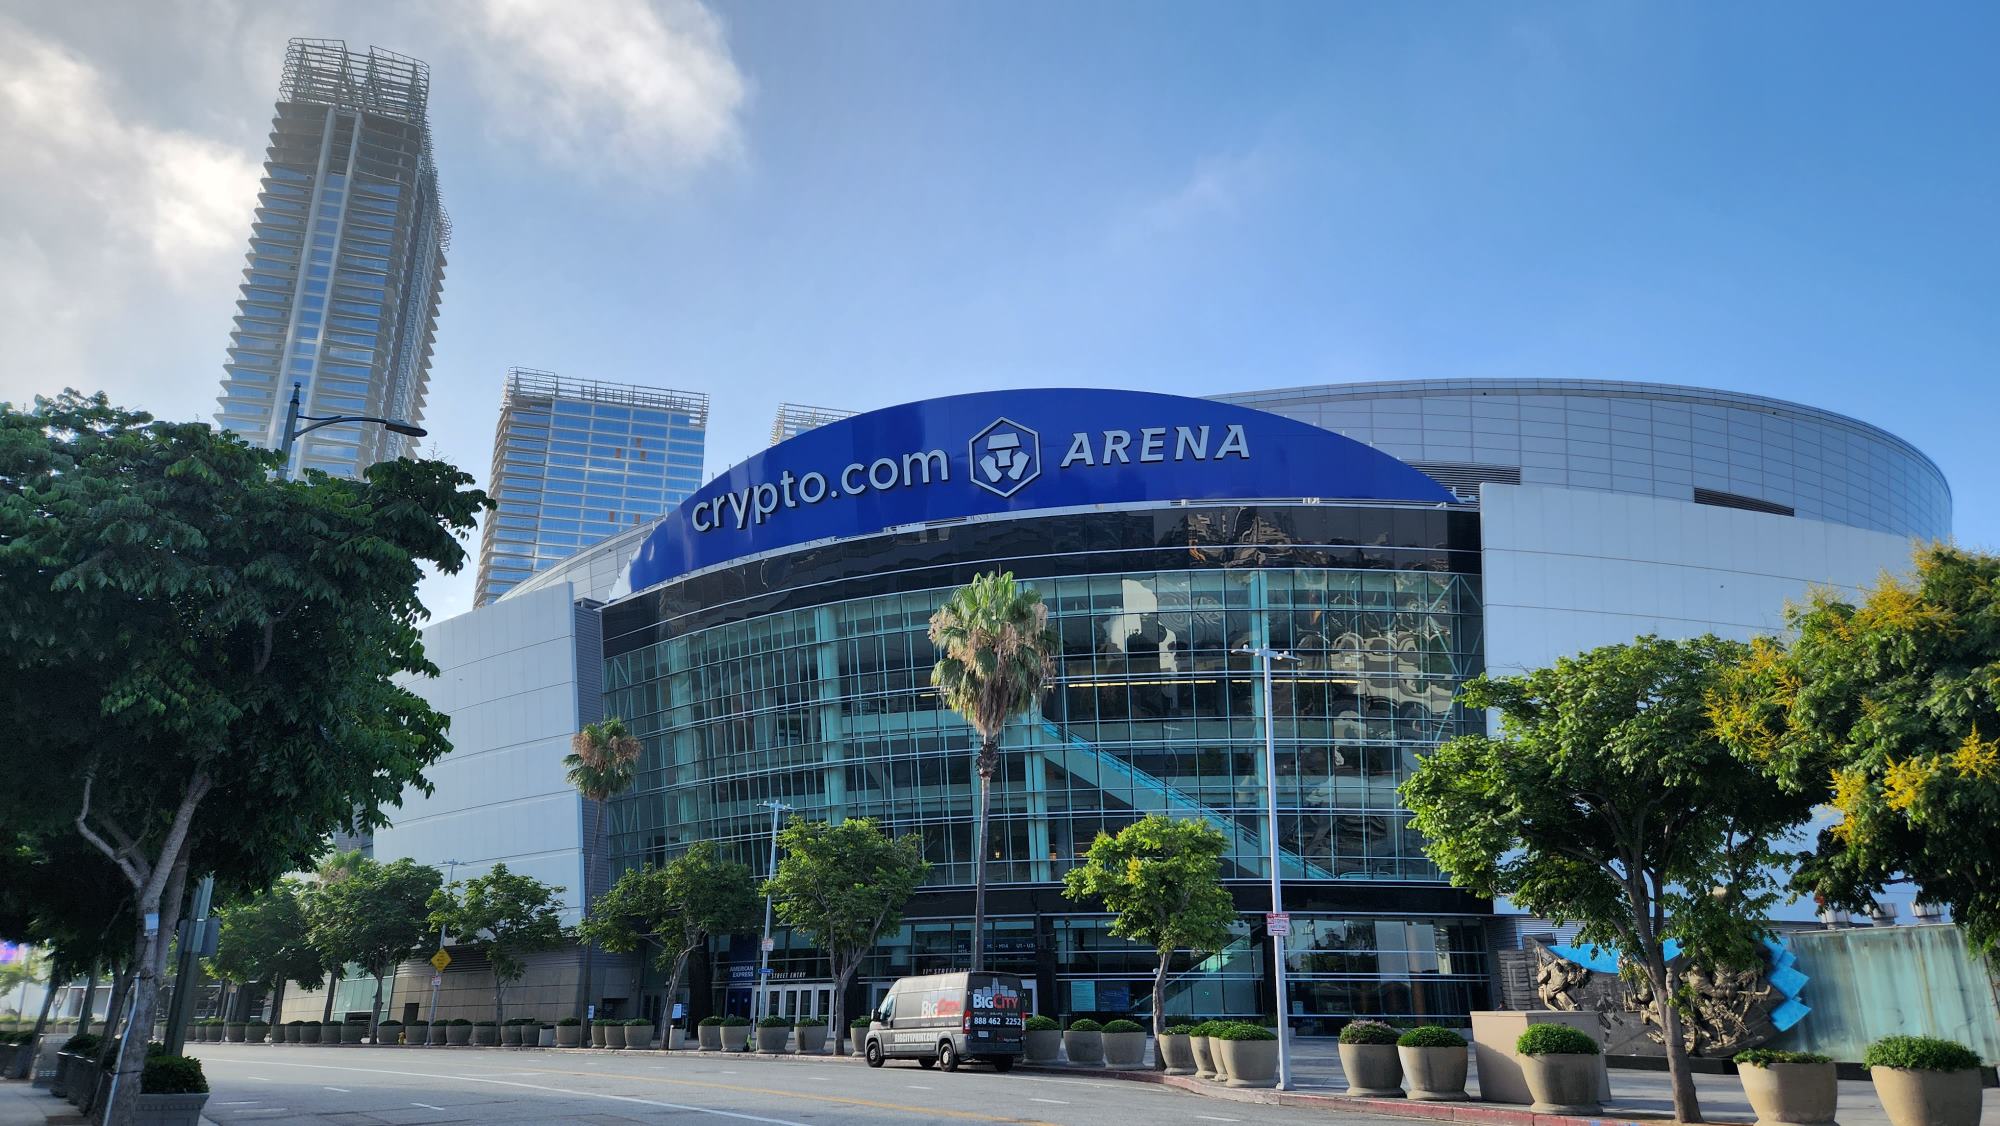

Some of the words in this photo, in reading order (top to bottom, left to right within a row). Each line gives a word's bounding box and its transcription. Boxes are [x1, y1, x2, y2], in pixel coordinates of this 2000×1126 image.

[691, 447, 948, 533] crypto.com
[1061, 424, 1250, 468] ARENA
[974, 1017, 987, 1025] 888
[988, 1017, 1001, 1025] 462
[1005, 1017, 1022, 1026] 2252
